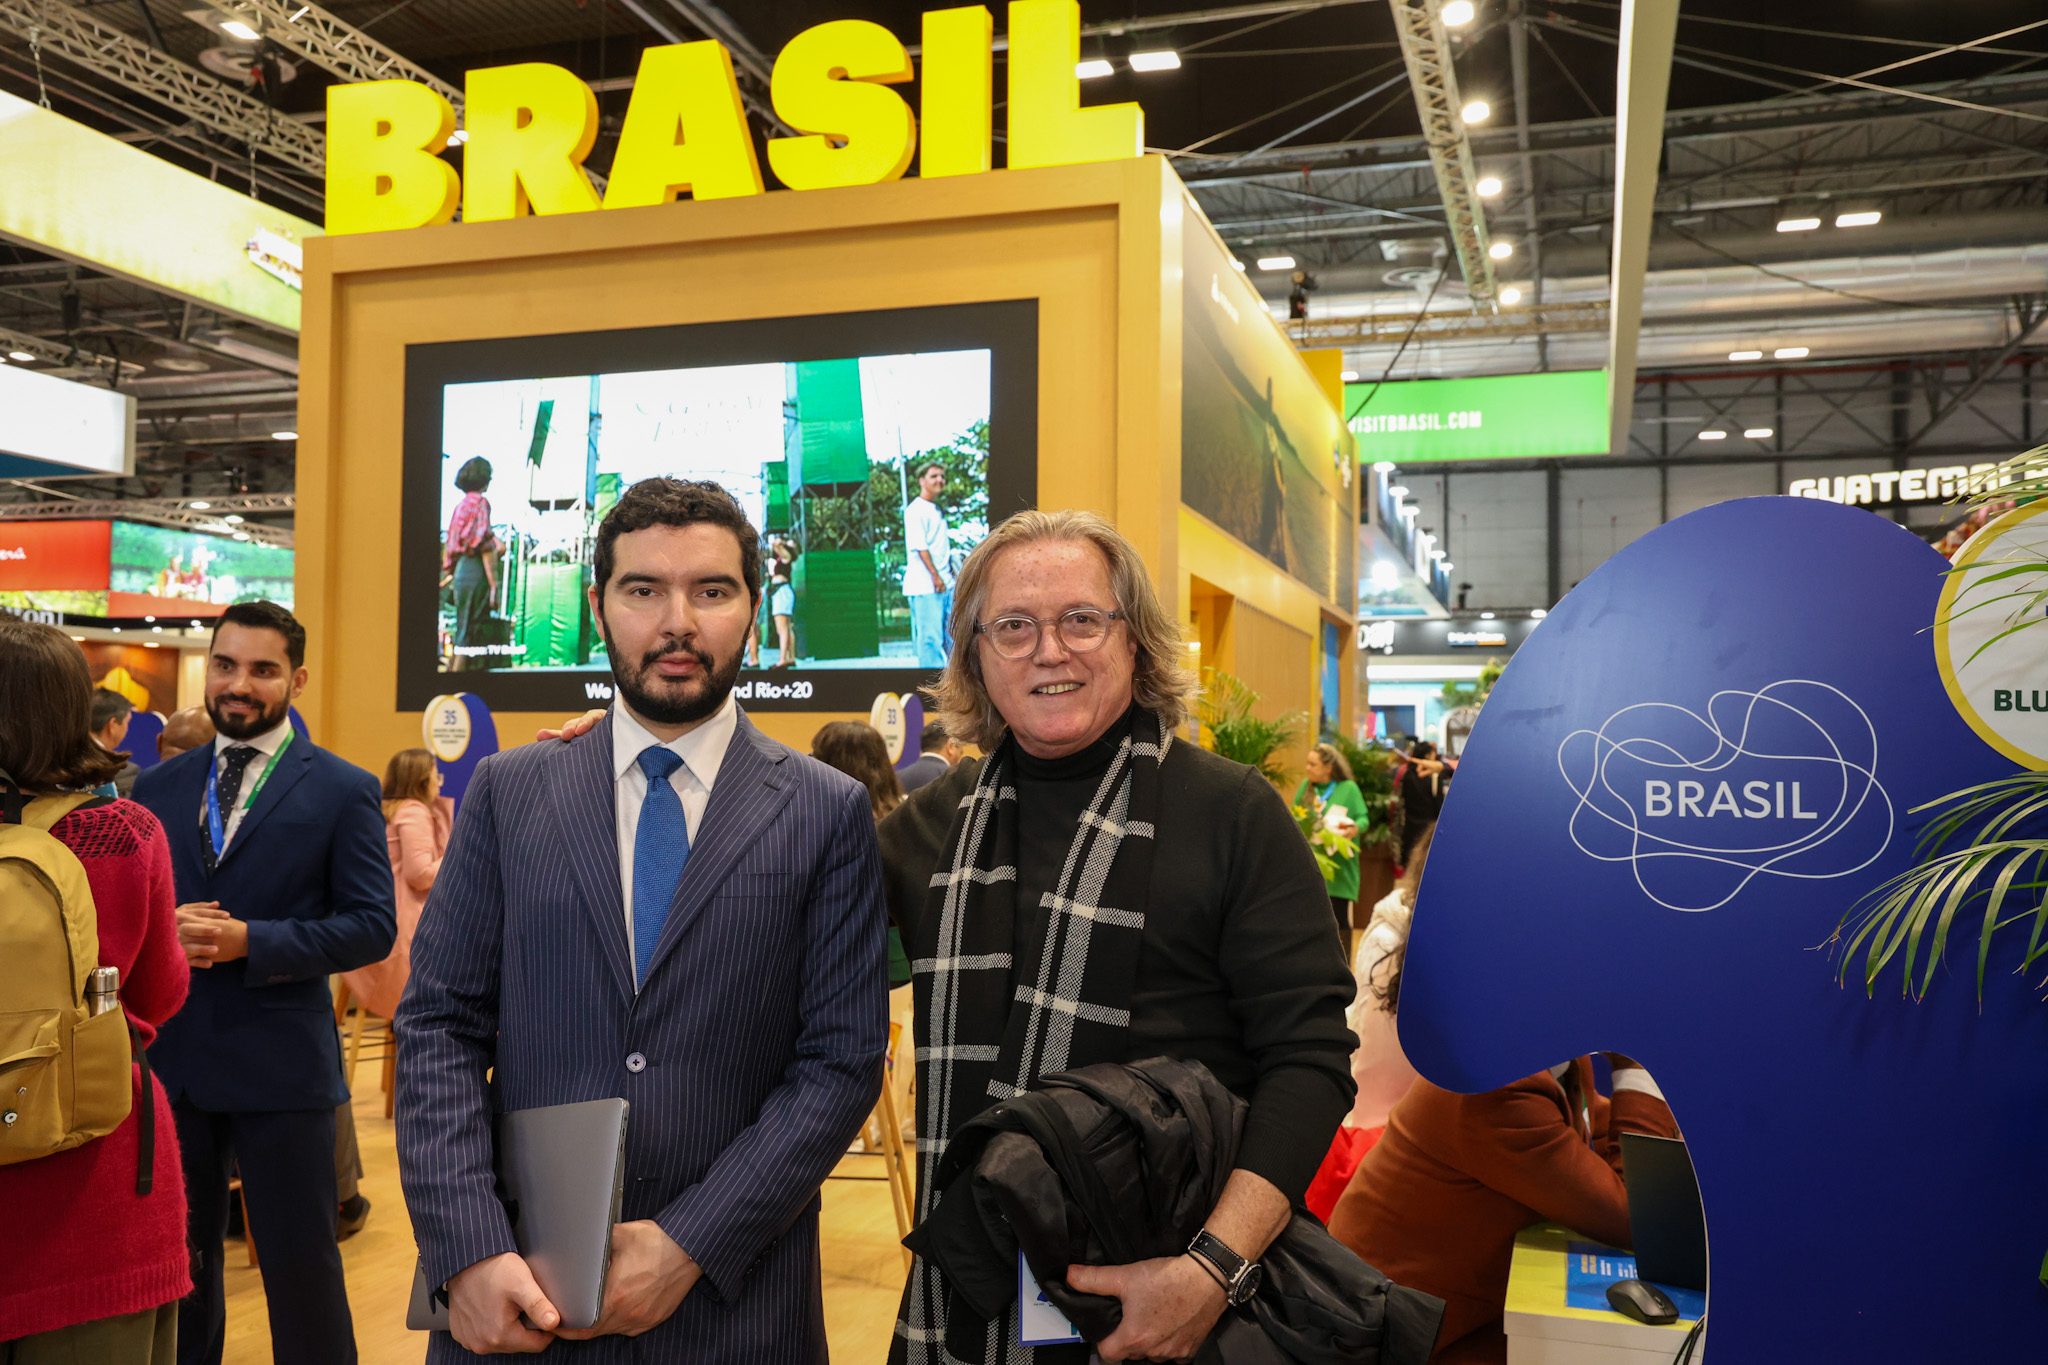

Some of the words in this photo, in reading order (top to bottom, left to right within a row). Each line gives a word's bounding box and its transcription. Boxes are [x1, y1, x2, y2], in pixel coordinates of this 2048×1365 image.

[325, 0, 1145, 237] BRASIL
[1347, 411, 1482, 434] VISITBRASIL.COM
[584, 682, 612, 699] We
[730, 681, 752, 699] nd
[755, 681, 814, 699] Rio+20
[444, 709, 458, 726] 35
[1645, 780, 1818, 820] BRASIL
